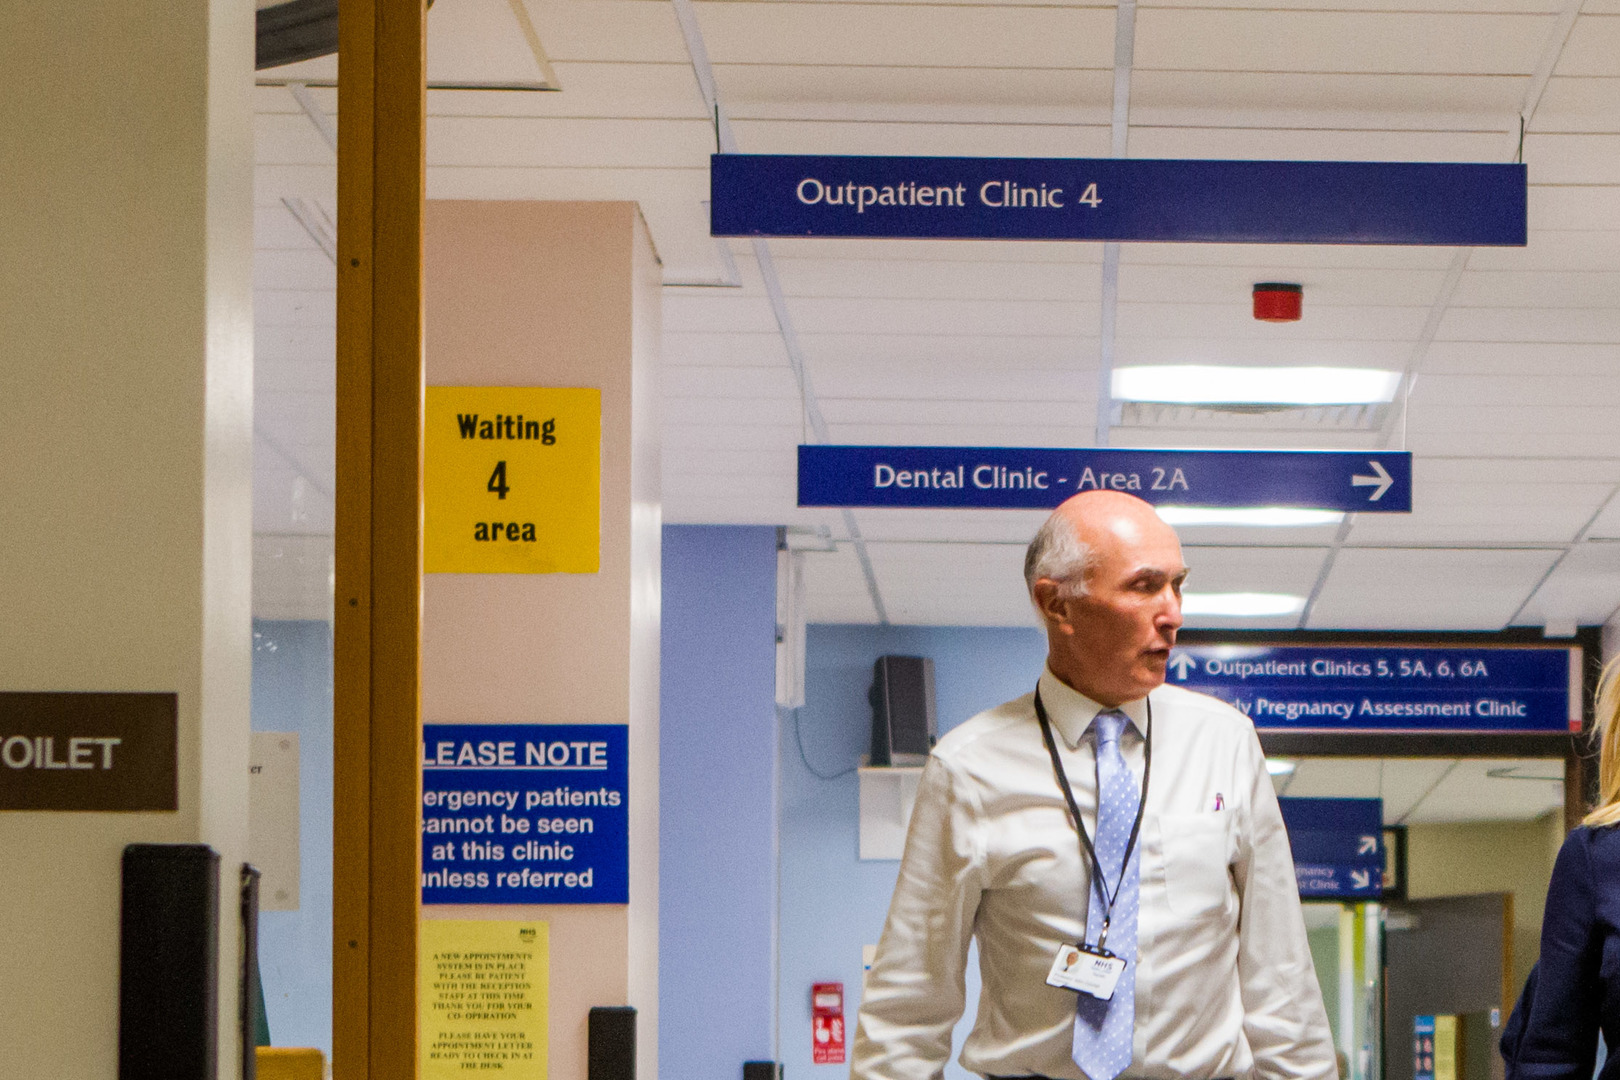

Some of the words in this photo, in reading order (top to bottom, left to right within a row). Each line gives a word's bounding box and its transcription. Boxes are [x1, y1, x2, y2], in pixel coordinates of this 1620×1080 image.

[796, 178, 967, 212] Outpatient
[979, 180, 1064, 209] Clinic
[1078, 182, 1103, 209] 4
[457, 413, 556, 446] Waiting
[487, 460, 510, 500] 4
[874, 462, 964, 489] Dental
[972, 464, 1049, 490] Clinic
[1077, 466, 1142, 491] Area
[1151, 466, 1190, 492] 2A
[474, 521, 537, 543] area
[1205, 658, 1306, 679] Outpatient
[1311, 659, 1371, 676] Clinics
[1377, 660, 1394, 679] 5,
[1400, 660, 1432, 679] 5A,
[1437, 661, 1455, 679] 6,
[1460, 661, 1488, 677] 6A
[1256, 697, 1355, 720] Pregnancy
[1359, 699, 1472, 718] Assessment
[1475, 700, 1527, 717] Clinic
[0, 735, 122, 769] OILET
[526, 742, 608, 766] NOTE
[526, 786, 622, 811] patients
[422, 815, 494, 834] annot
[501, 813, 531, 834] be
[537, 819, 594, 834] seen
[432, 842, 455, 861] at
[462, 841, 505, 861] this
[511, 840, 574, 861] clinic
[496, 867, 593, 888] referred
[1095, 959, 1114, 970] NHS
